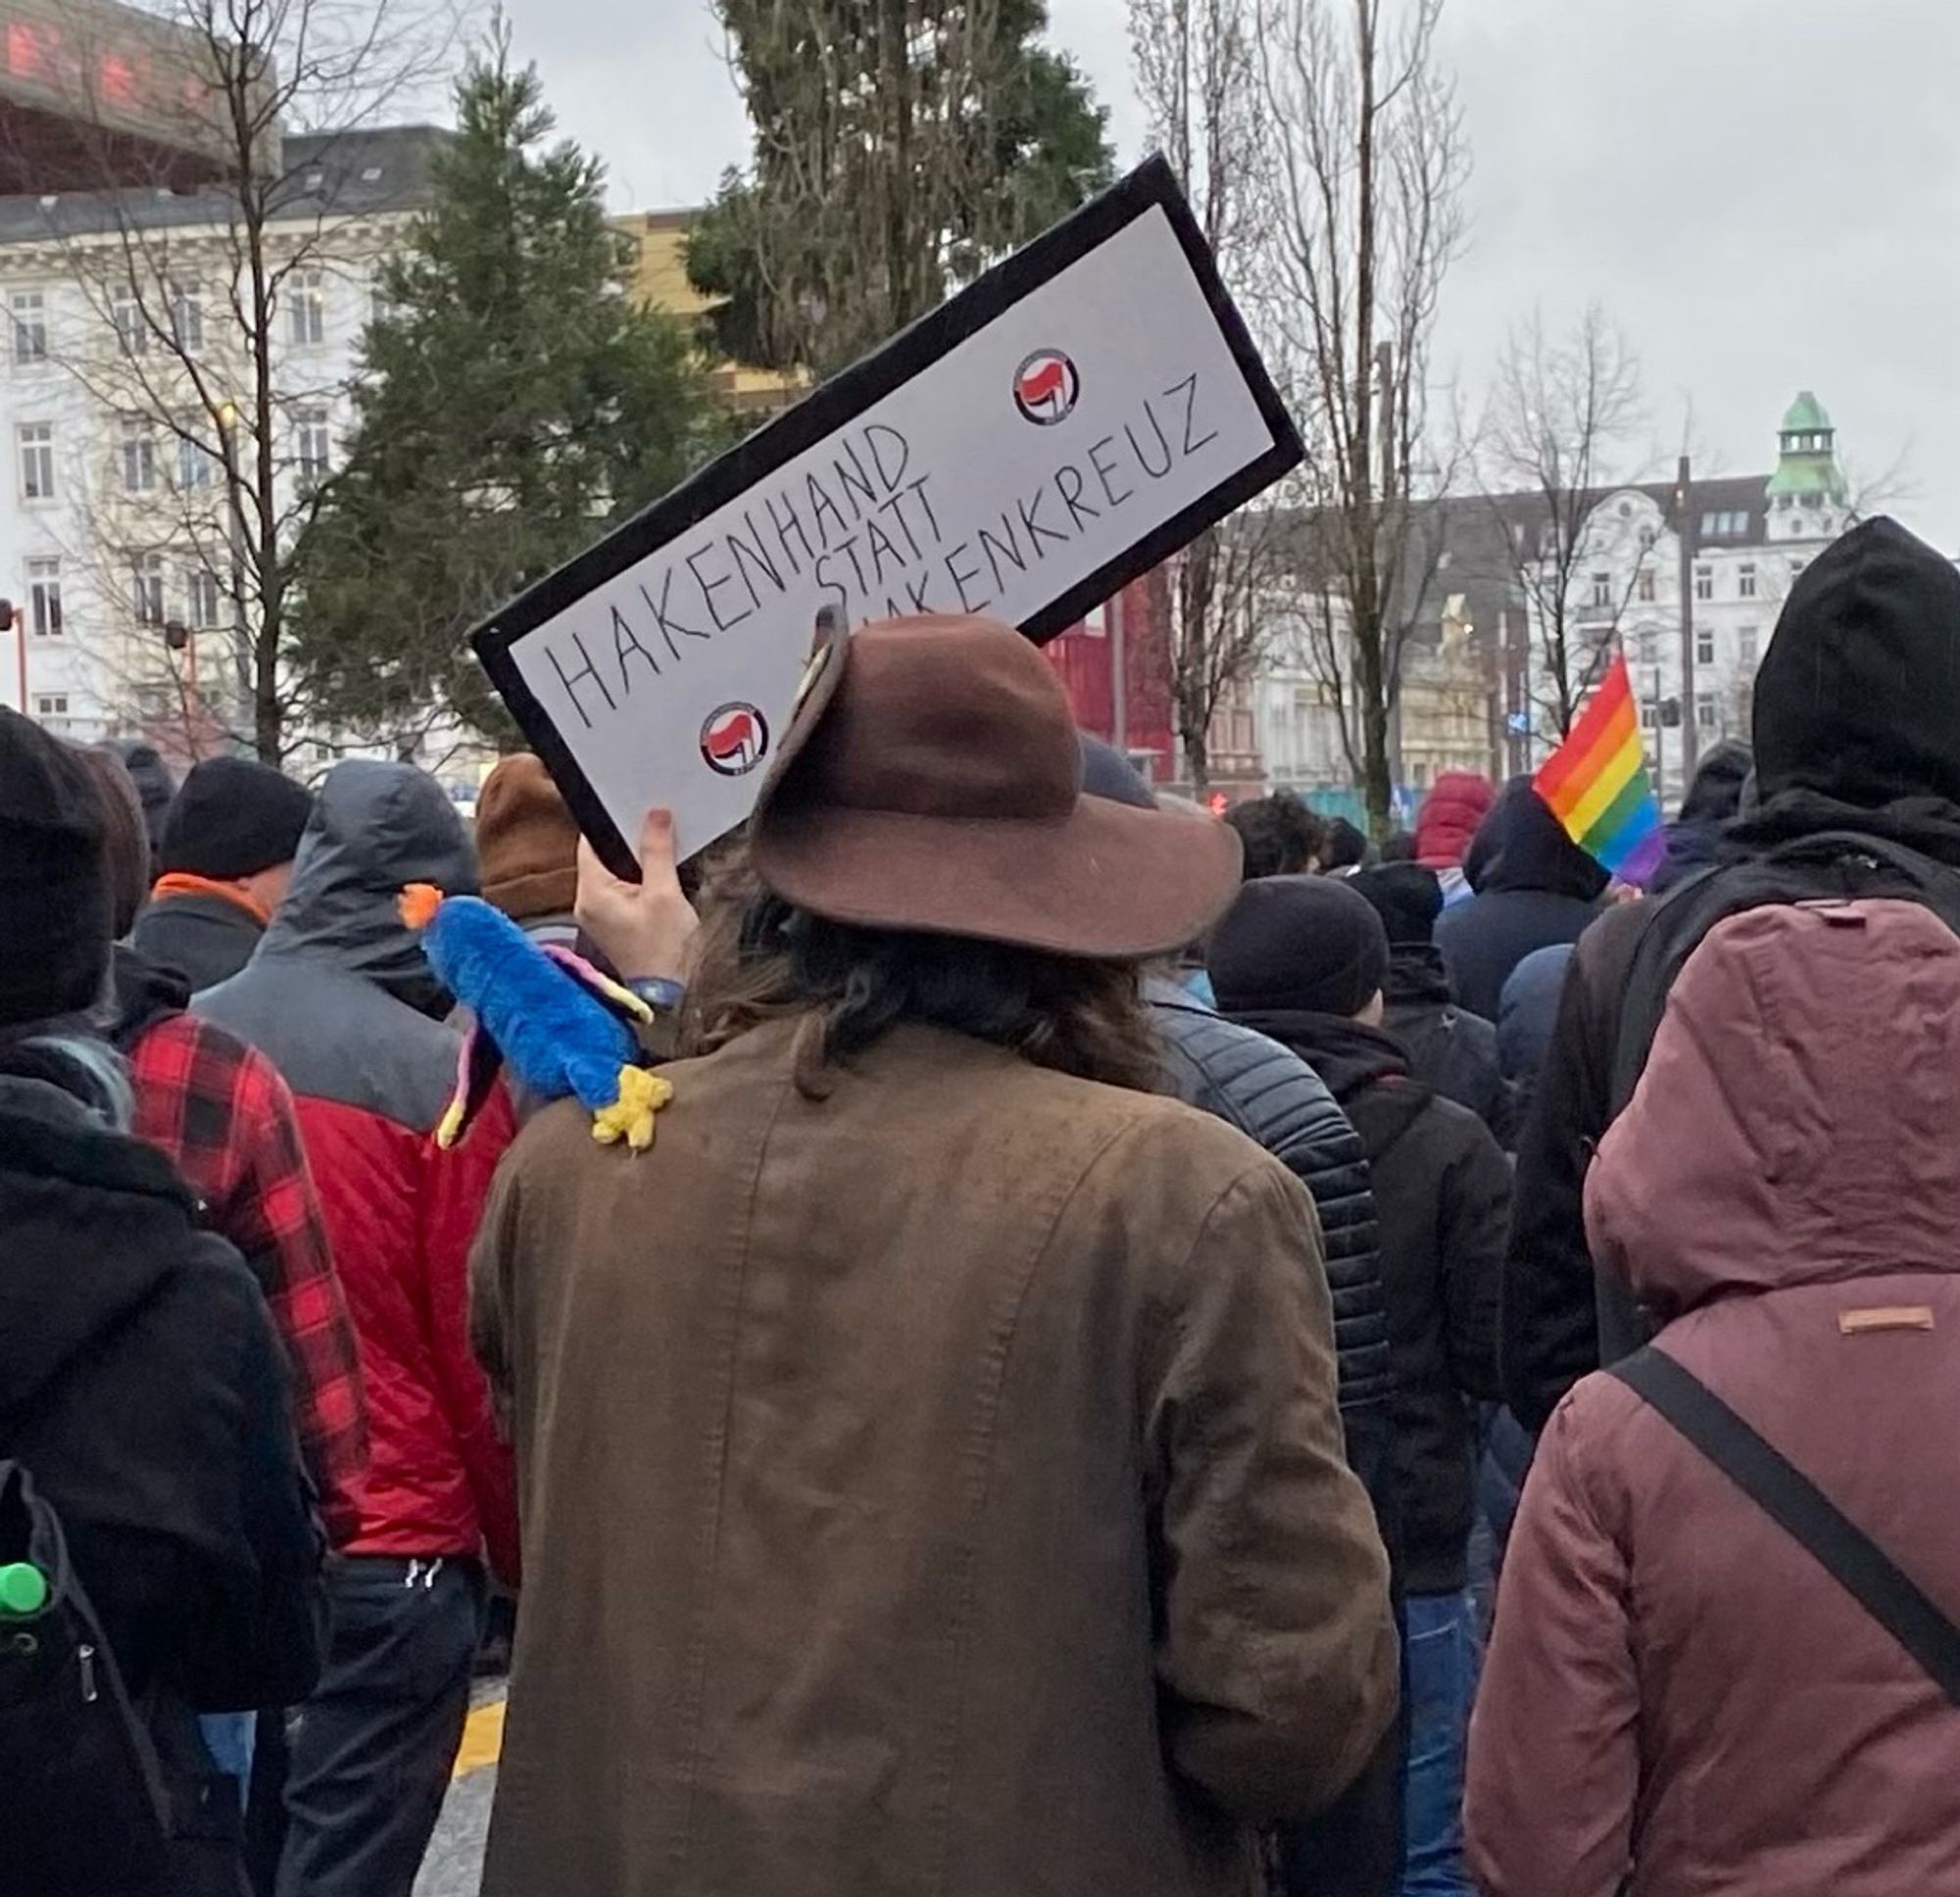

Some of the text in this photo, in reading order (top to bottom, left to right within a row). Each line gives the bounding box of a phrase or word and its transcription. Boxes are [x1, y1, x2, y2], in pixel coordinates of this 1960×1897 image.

[544, 424, 909, 728] HAKENHAND
[815, 473, 942, 608] STATT
[862, 371, 1219, 626] KENKREUZ
